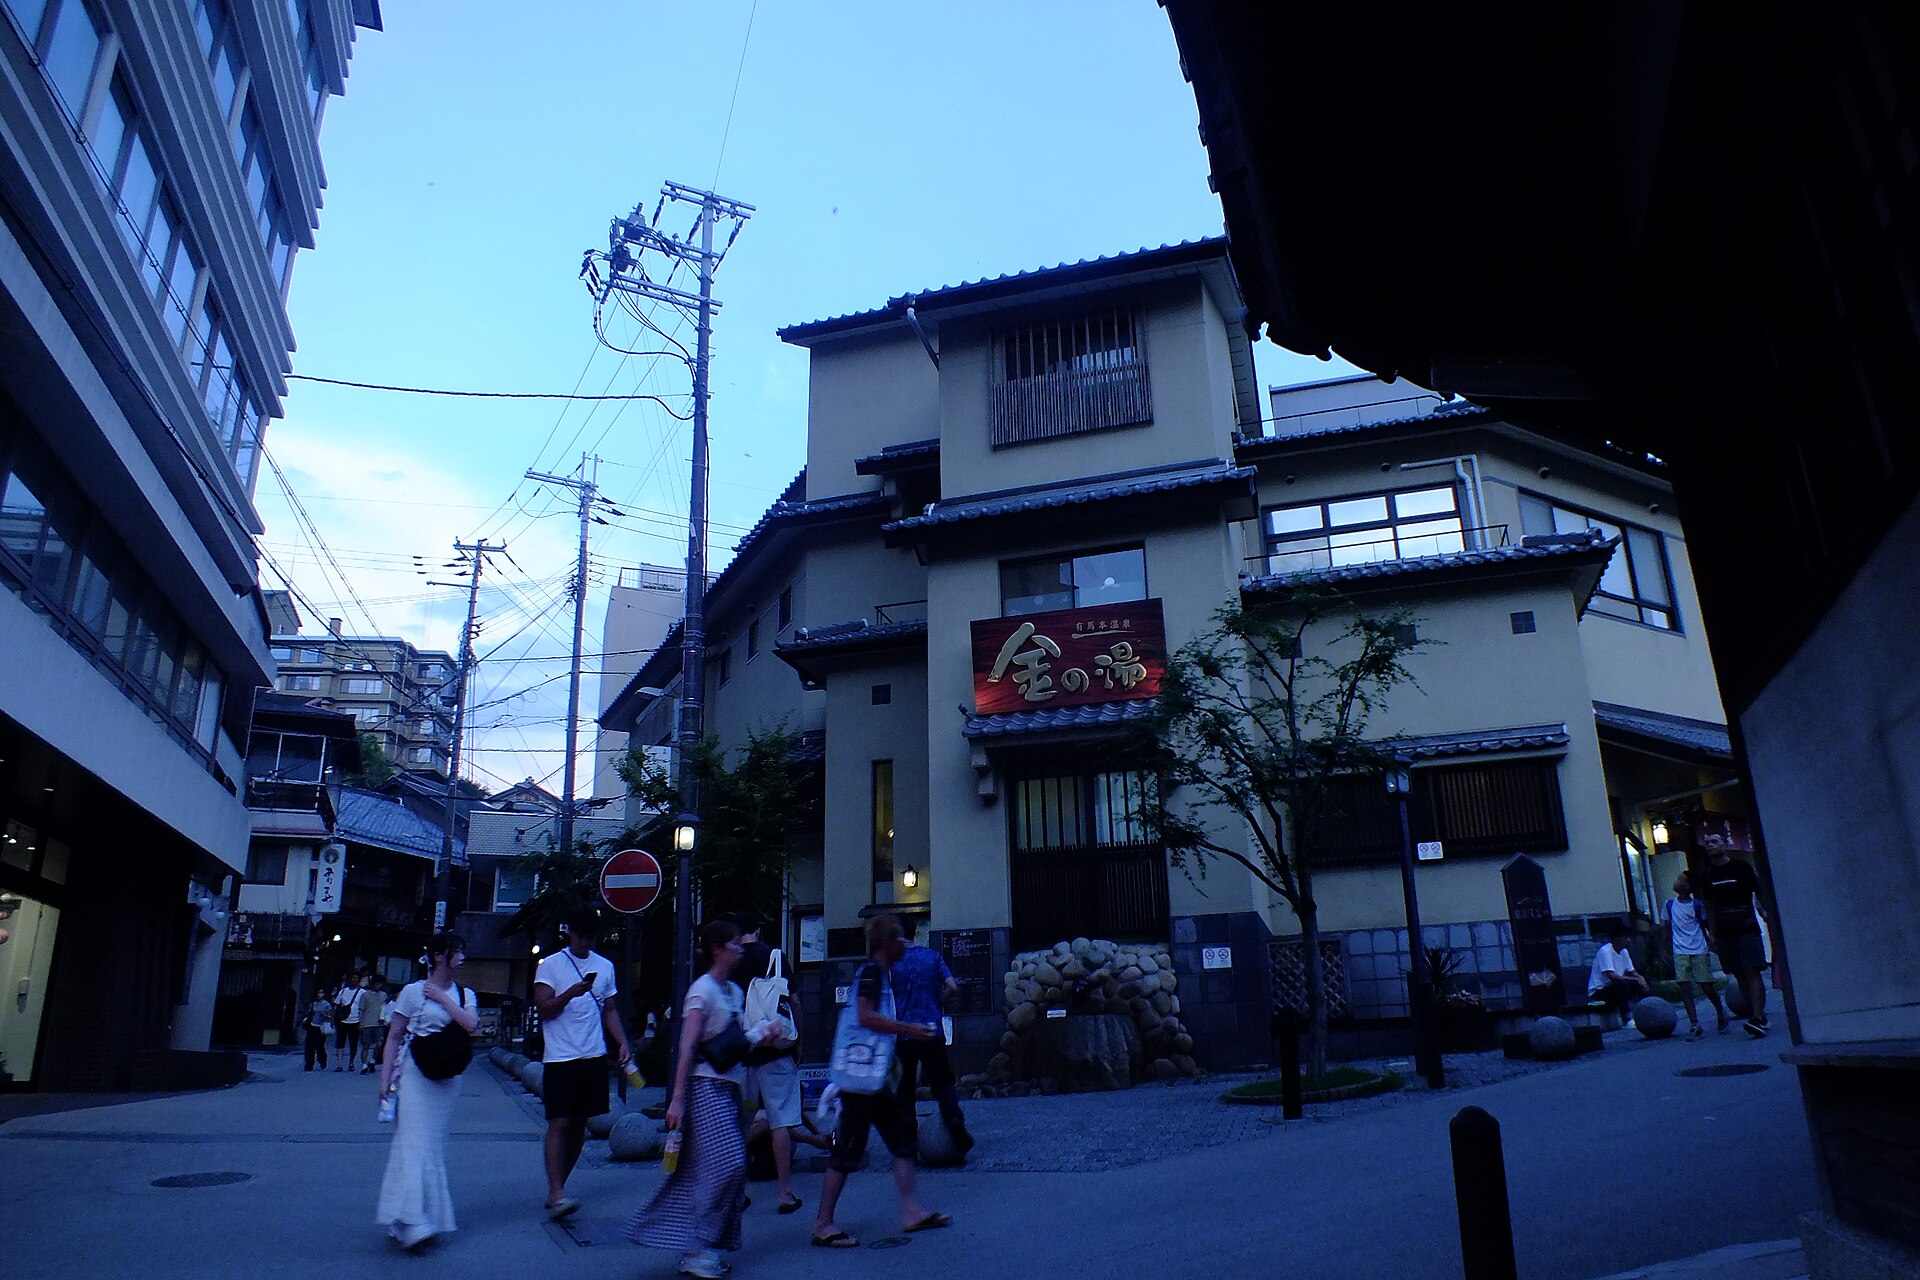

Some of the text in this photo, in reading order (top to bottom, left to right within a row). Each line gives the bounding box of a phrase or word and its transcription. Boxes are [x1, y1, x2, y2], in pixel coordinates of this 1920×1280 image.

[1074, 618, 1132, 632] 有馬本温泉
[986, 621, 1148, 703] 金の湯
